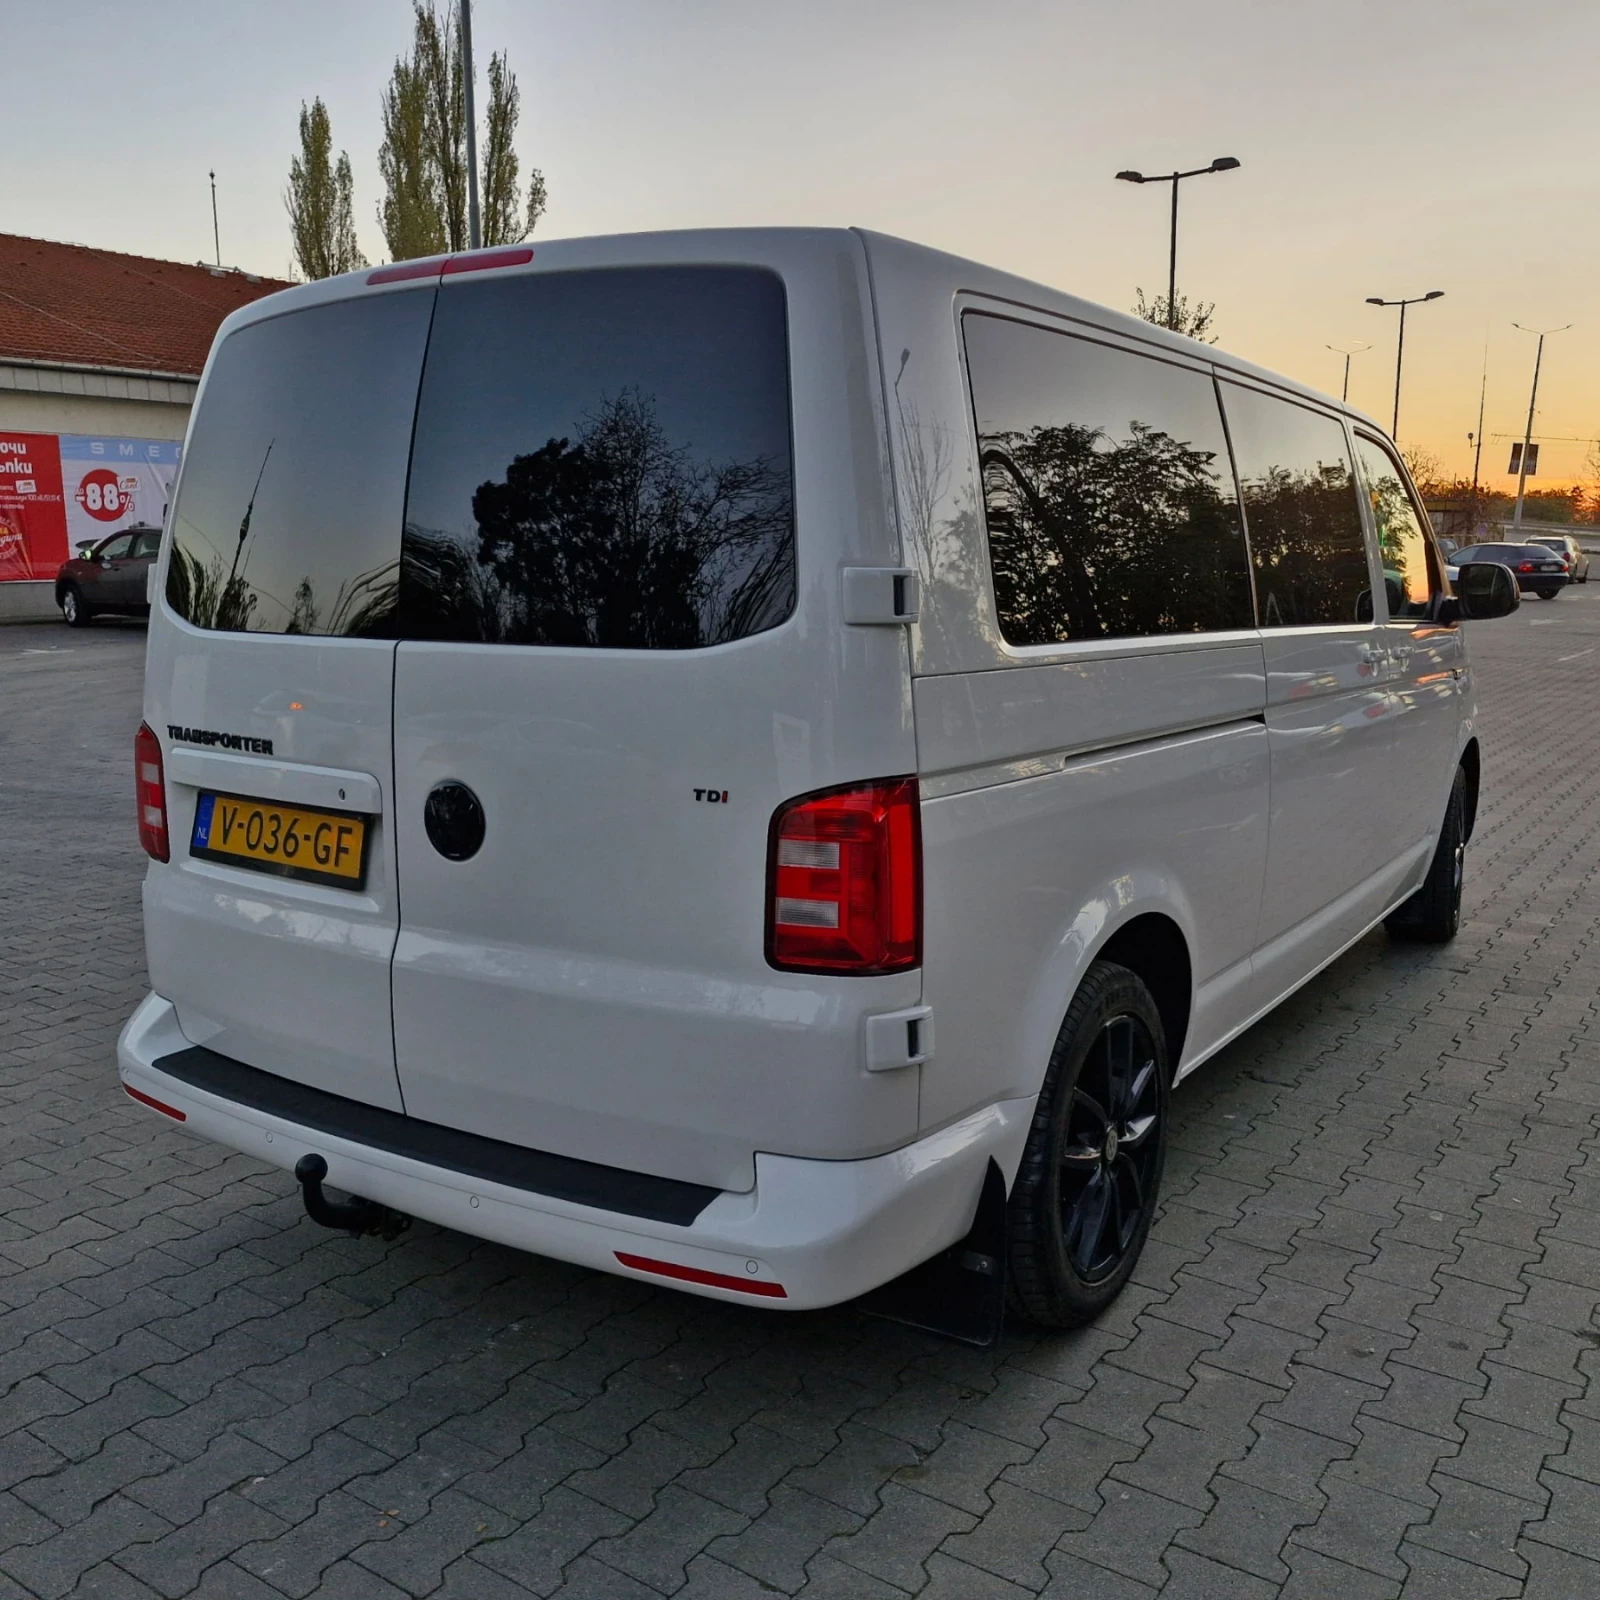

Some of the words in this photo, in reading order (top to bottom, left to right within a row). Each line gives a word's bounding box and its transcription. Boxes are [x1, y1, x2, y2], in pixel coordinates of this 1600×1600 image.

[166, 724, 274, 756] TRANSPORTER
[692, 787, 729, 804] TDI
[196, 825, 208, 841] NL
[221, 804, 353, 868] V-036-GF
